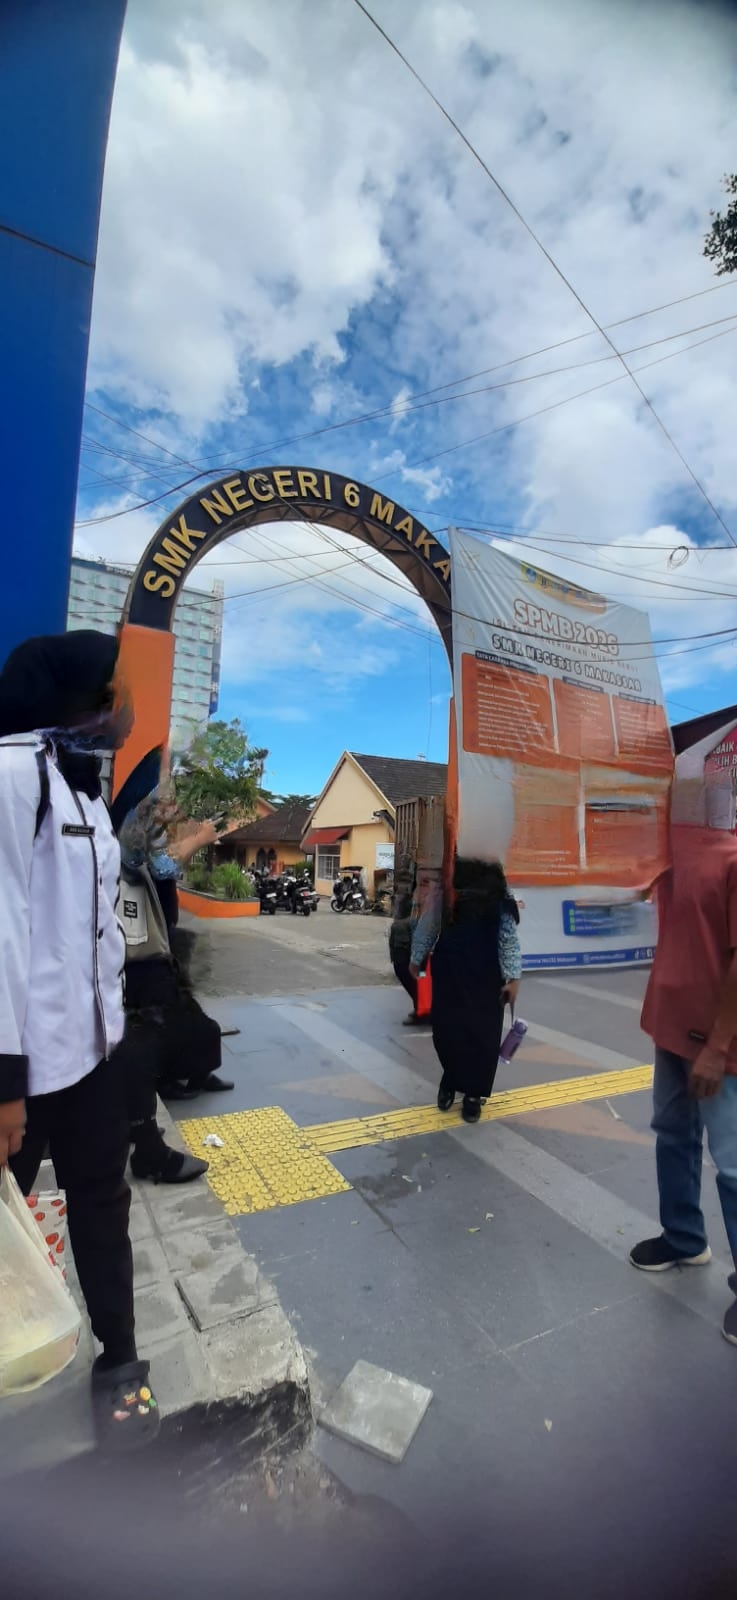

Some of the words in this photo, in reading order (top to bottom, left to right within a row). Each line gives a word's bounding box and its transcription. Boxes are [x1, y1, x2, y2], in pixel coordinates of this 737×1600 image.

[143, 514, 206, 599] SMK
[199, 470, 333, 525] NEGERI
[343, 482, 360, 507] 6
[514, 598, 575, 641] SPMB
[491, 633, 526, 657] SMK
[525, 645, 571, 672] NEGERI
[584, 664, 642, 692] MAKASSAR
